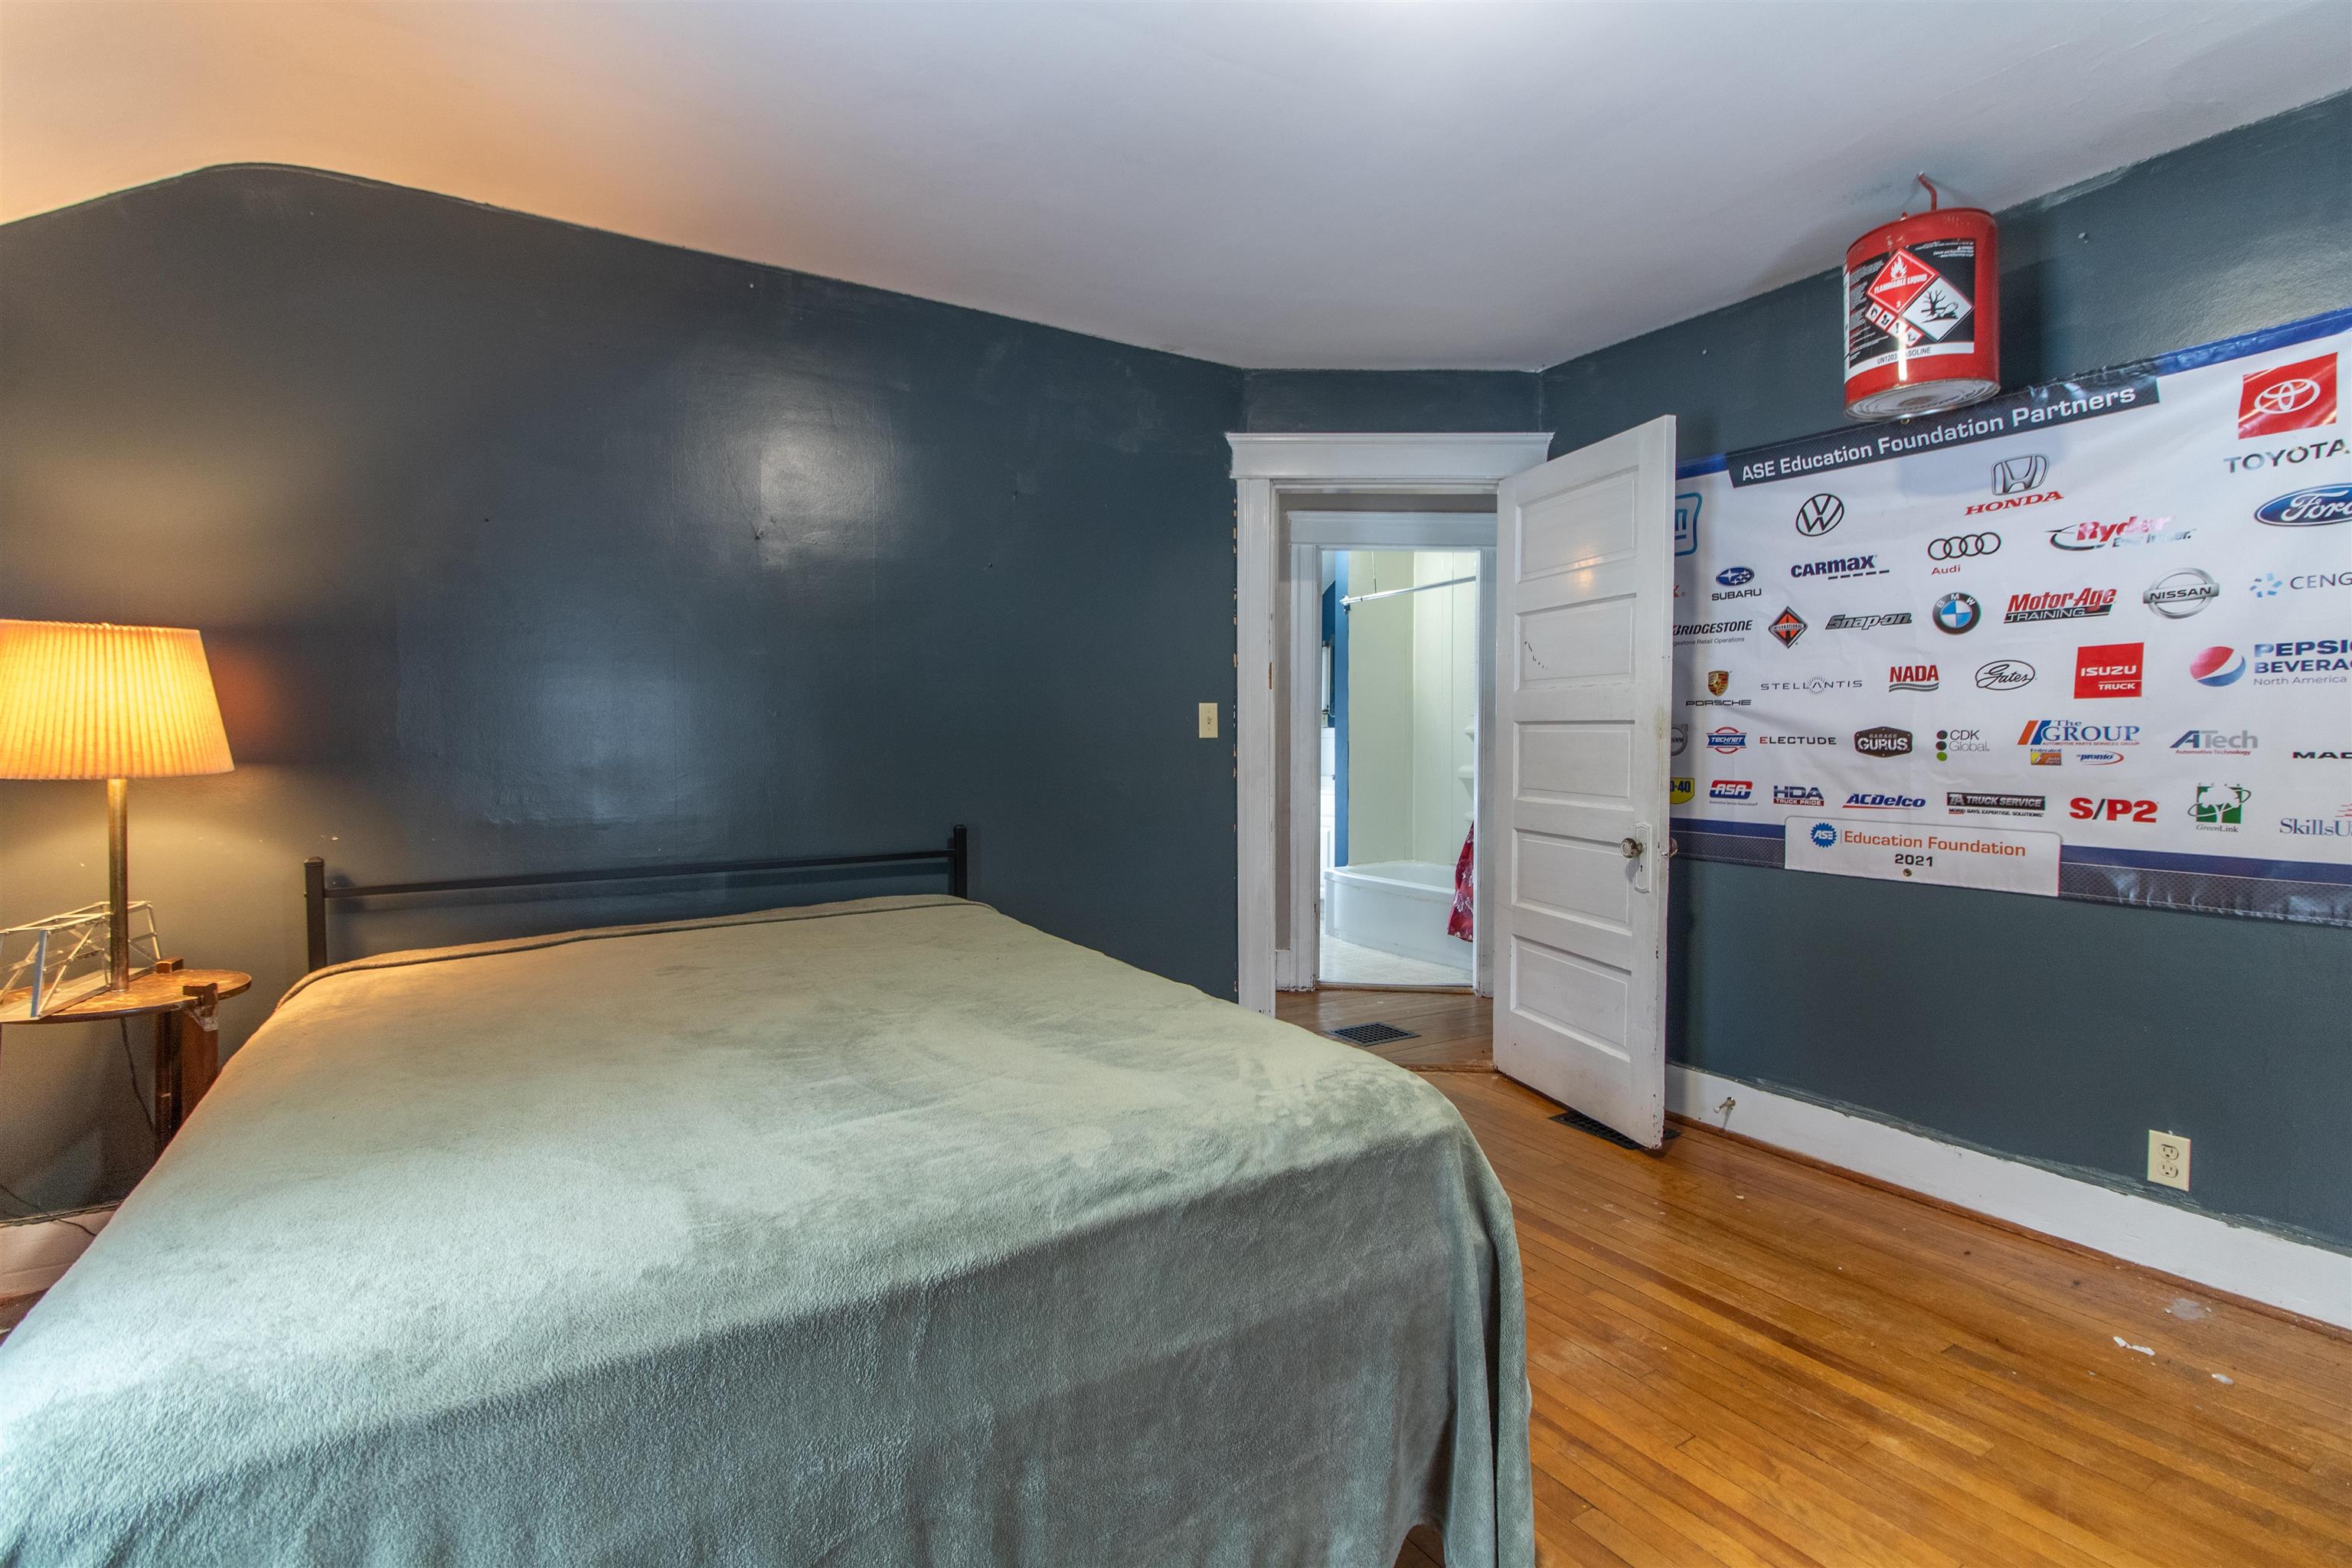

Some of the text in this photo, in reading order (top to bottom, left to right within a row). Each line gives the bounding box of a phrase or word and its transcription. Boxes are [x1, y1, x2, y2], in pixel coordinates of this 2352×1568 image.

[1873, 273, 1928, 295] FLAMMABLE LIQUID
[1877, 346, 1932, 365] UN1203 SOLINE
[1742, 387, 2136, 482] ASE Education Foundation Partners
[2223, 439, 2350, 473] TOYOTA
[1964, 490, 2065, 516] HONDA
[1931, 564, 1961, 576] Audi
[2290, 571, 2352, 590] CENG
[1711, 588, 1762, 601] SUBARU
[2150, 586, 2213, 601] NISSAN
[2004, 607, 2086, 622] TRAINING
[1673, 619, 1754, 636] BRIDGESTONE
[2254, 639, 2352, 658] PEPSI
[2080, 665, 2137, 677] ISUZU
[2254, 658, 2352, 674] BEVERA
[1889, 665, 1939, 683] NADA
[1977, 664, 2032, 689] Gates
[2253, 675, 2348, 686] North America
[1761, 680, 1863, 691] STELLANTIS
[2097, 682, 2136, 691] TRUCK
[1759, 736, 1838, 745] ELECTUDE
[1949, 730, 1981, 741] CDK
[2042, 726, 2141, 742] GROUP
[1857, 737, 1909, 751] GURUS
[1714, 783, 1747, 796] ASA
[1773, 786, 1824, 799] HDA
[1845, 793, 1926, 808] ACDelco
[1949, 793, 2043, 807] TA TRUCK SERVICE
[2069, 797, 2158, 823] S/P2
[2279, 817, 2352, 837] SkillsU
[1813, 830, 2026, 857] ASE Education Foundation
[1894, 853, 1933, 867] 2021
